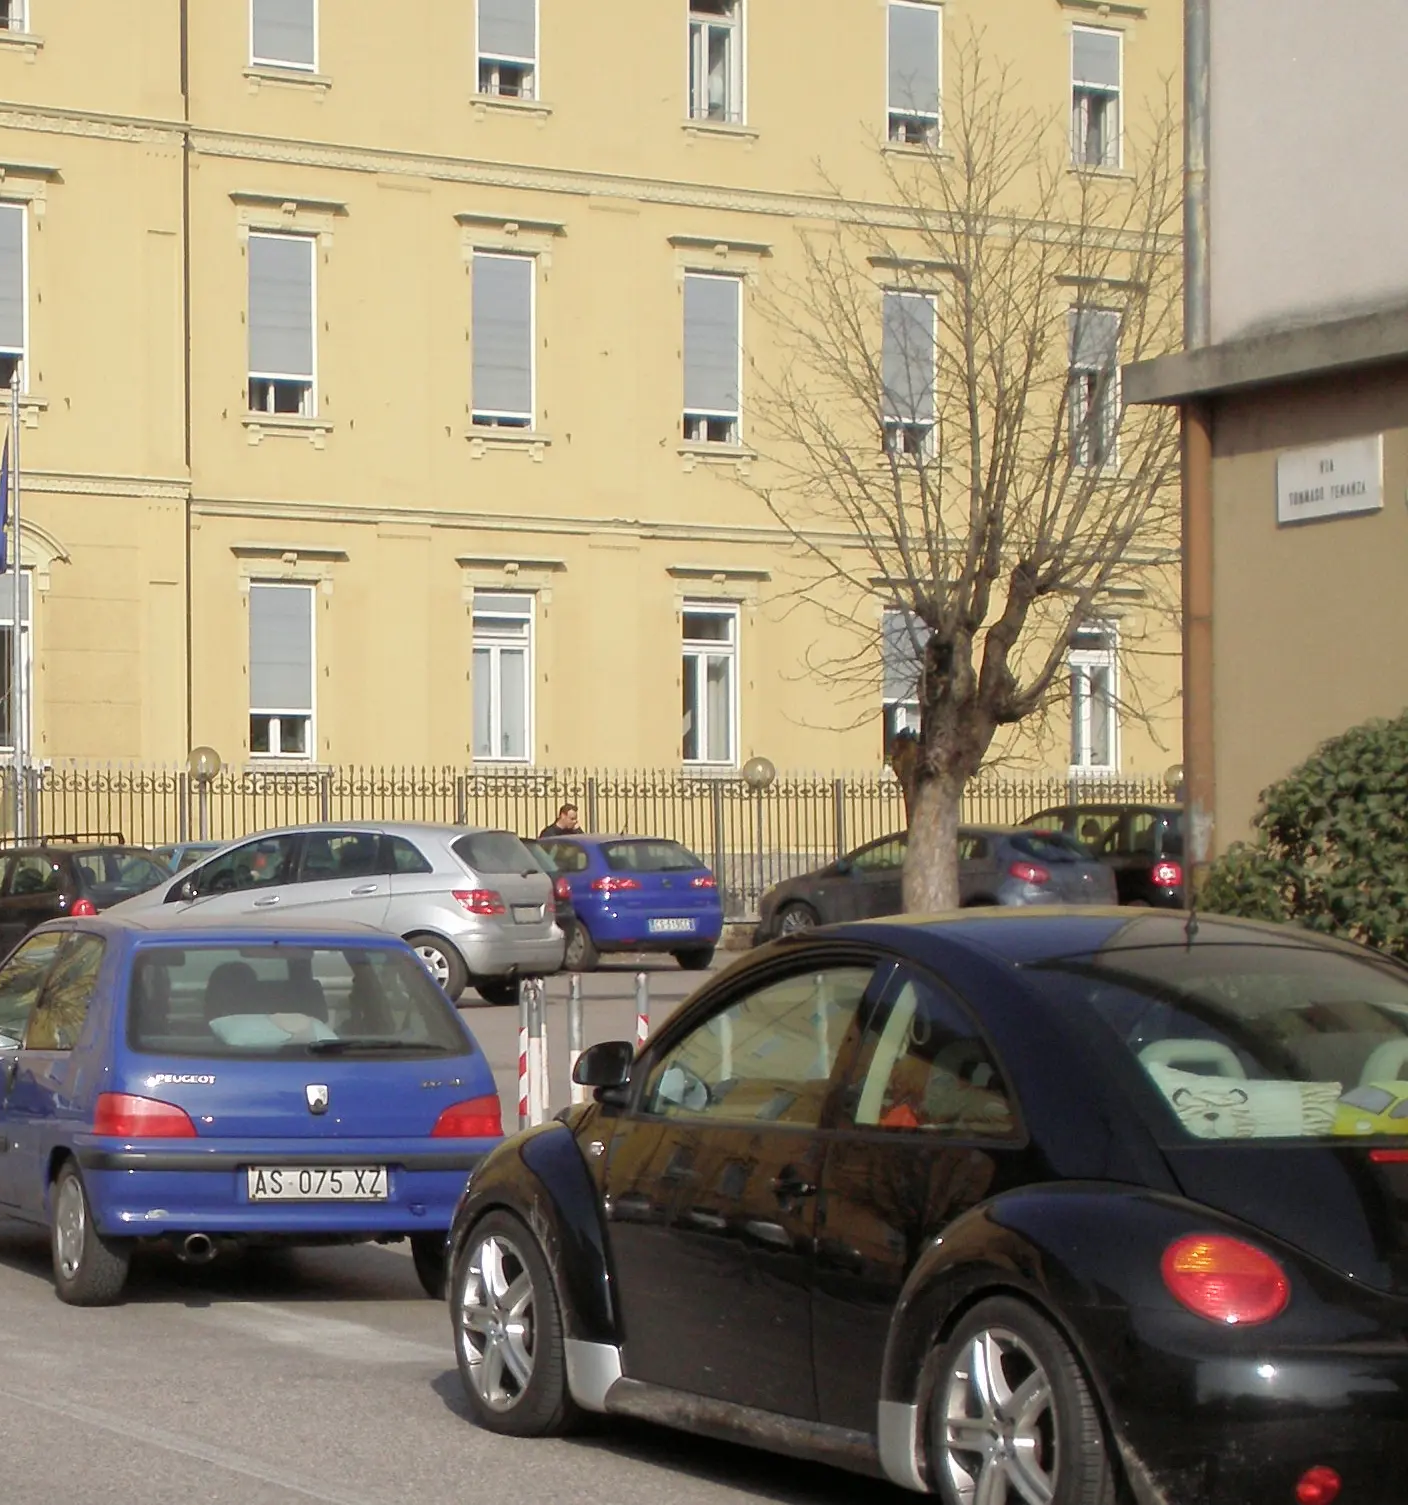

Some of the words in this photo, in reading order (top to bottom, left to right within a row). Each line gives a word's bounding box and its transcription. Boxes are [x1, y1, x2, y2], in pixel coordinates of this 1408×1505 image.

[1319, 459, 1334, 474] VIA
[155, 1073, 216, 1084] PEUGEOT
[254, 1170, 283, 1195] AS
[298, 1170, 343, 1194] 075
[354, 1169, 381, 1194] XZ
